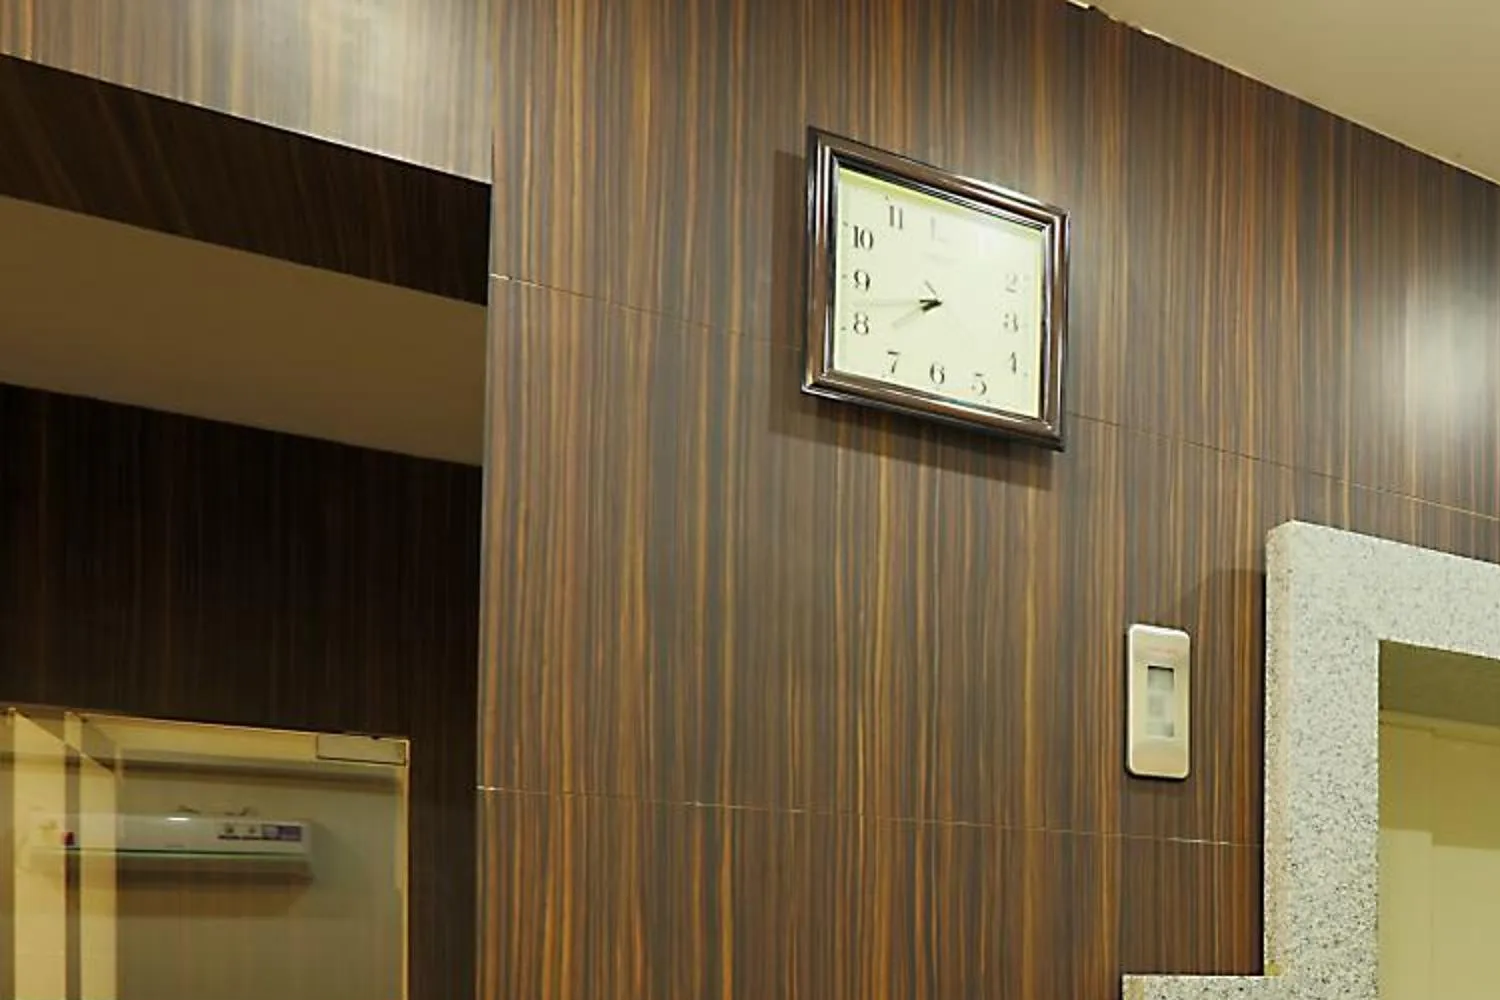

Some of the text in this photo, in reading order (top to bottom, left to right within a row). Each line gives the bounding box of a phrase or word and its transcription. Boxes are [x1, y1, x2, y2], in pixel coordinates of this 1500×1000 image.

[889, 205, 904, 230] 11
[853, 225, 873, 250] 10
[853, 269, 871, 291] 9
[853, 312, 869, 336] 8
[887, 350, 900, 374] 7
[929, 362, 945, 385] 6
[971, 373, 987, 396] 5
